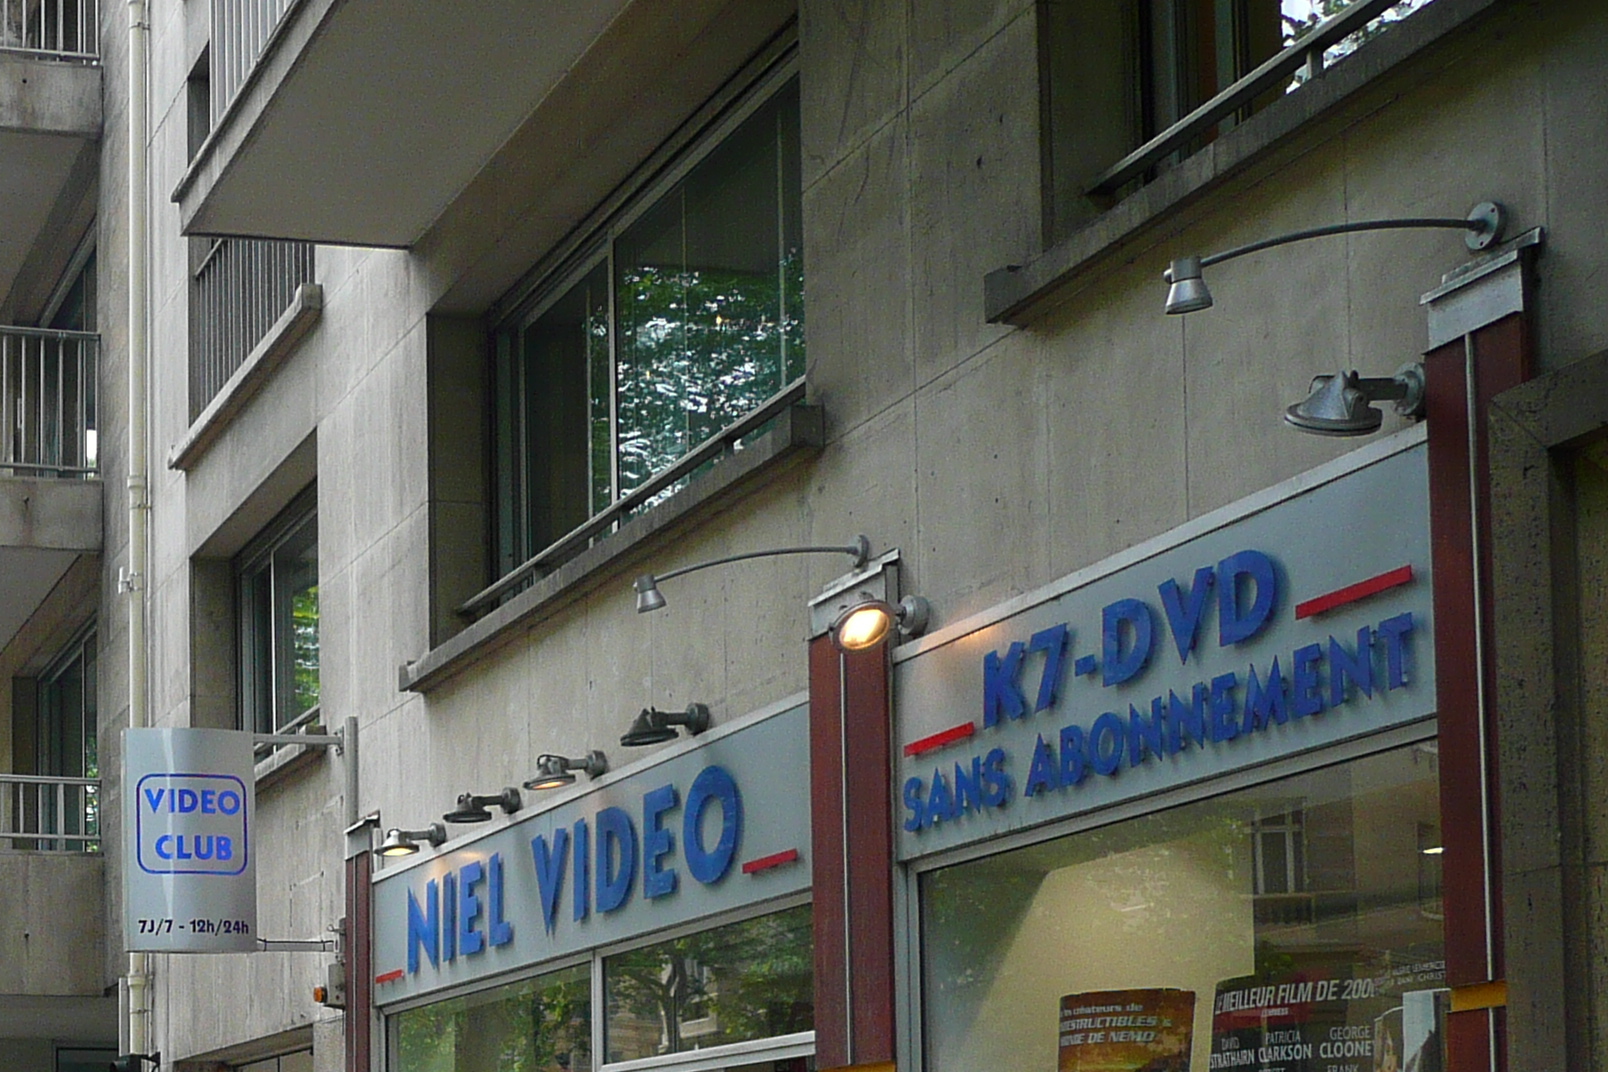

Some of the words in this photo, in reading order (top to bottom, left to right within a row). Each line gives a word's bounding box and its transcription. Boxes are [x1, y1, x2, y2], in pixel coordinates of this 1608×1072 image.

[982, 548, 1276, 730] K7-DVD
[903, 747, 1008, 833] SANS
[1024, 611, 1414, 797] ABONNEMENT
[144, 787, 241, 816] VIDEO
[154, 833, 233, 861] CLUB
[406, 852, 514, 975] NIEL
[530, 764, 745, 937] VIDEO
[137, 917, 174, 936] 7J/7
[189, 917, 250, 937] 12h/24h
[1223, 985, 1275, 1012] MEILLEUR
[1277, 982, 1313, 1006] FILM
[1315, 980, 1339, 1001] DE
[1108, 1030, 1156, 1043] NEMO
[1329, 1025, 1371, 1041] GEORGE
[1258, 1043, 1312, 1064] CLARKSON
[1319, 1040, 1375, 1059] CLOONE
